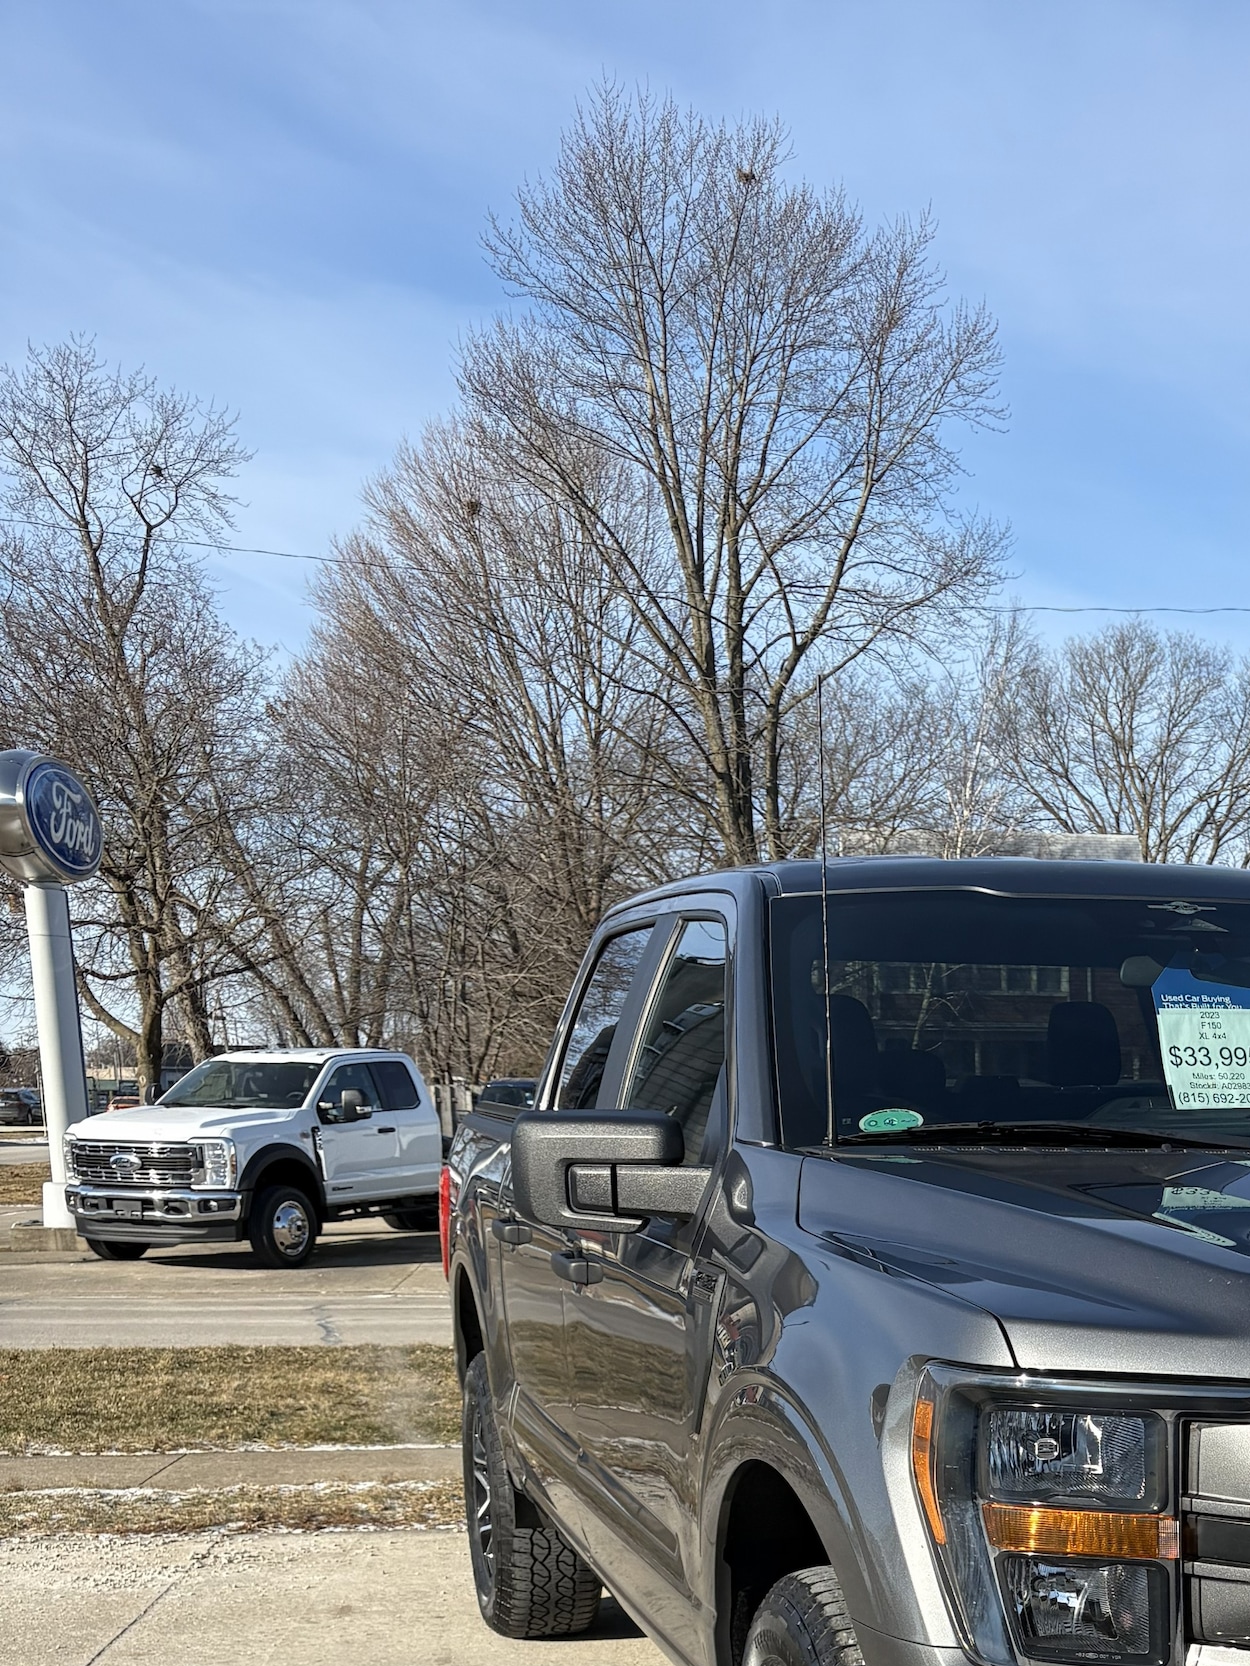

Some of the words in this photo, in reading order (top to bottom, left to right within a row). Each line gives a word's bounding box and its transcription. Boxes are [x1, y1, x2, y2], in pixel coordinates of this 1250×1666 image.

[50, 781, 95, 857] Ford
[1201, 995, 1231, 1004] Buying
[1200, 1011, 1220, 1019] 2023
[1201, 1022, 1222, 1030] F150
[1199, 1032, 1210, 1040] XL
[1212, 1032, 1227, 1040] 4x4
[1192, 1072, 1216, 1080] Miles:
[1178, 1091, 1210, 1105] (815)
